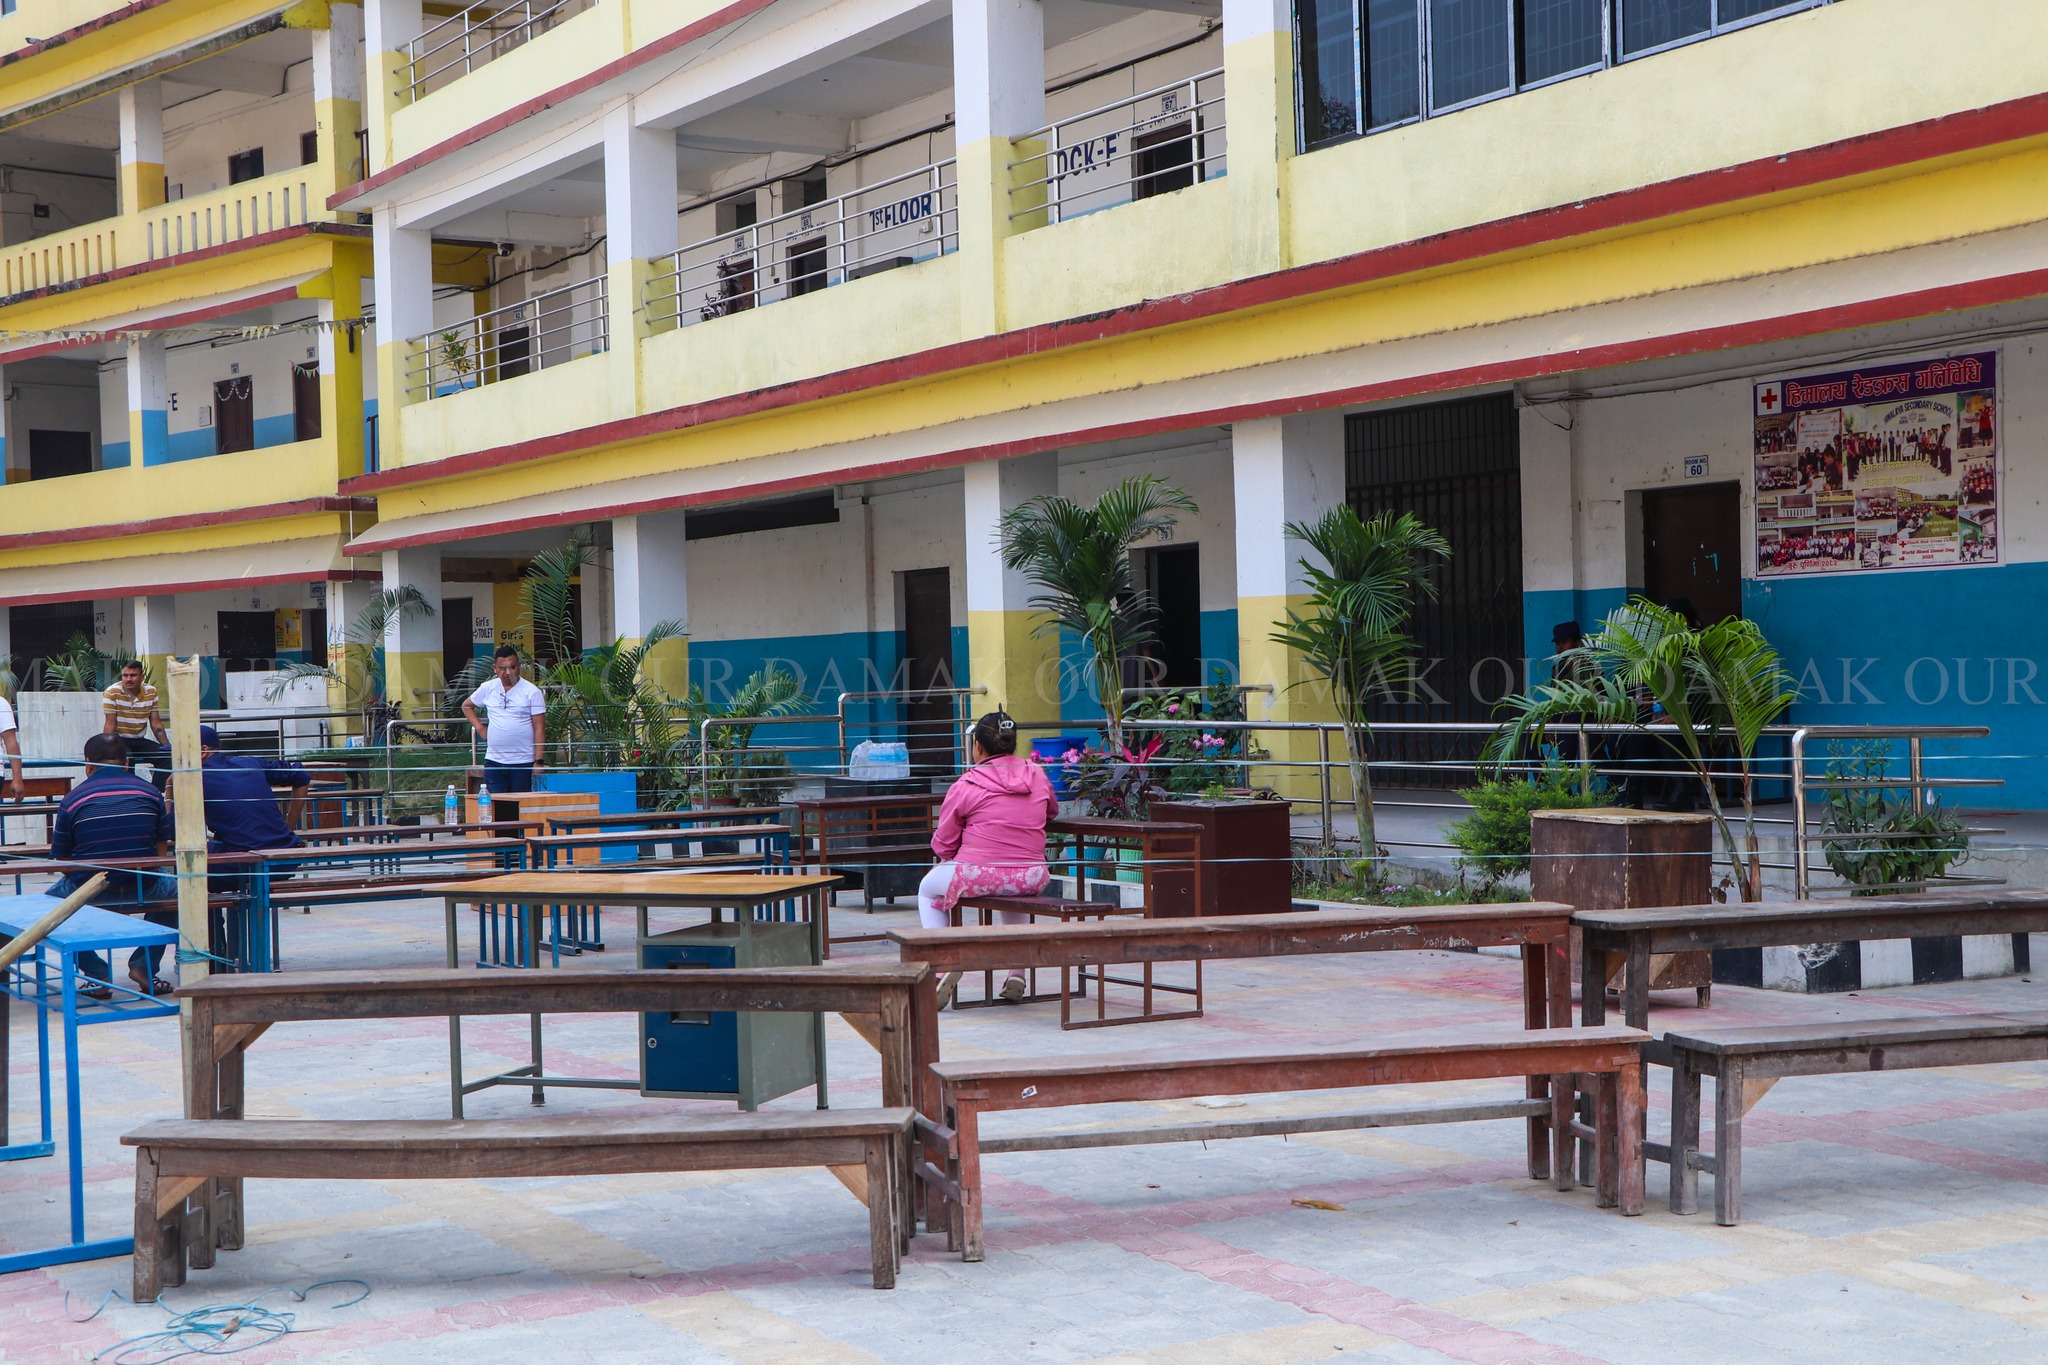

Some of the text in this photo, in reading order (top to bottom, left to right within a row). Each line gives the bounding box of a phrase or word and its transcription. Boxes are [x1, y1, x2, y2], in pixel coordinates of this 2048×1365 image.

[1165, 100, 1173, 110] 67
[884, 192, 933, 229] FLOOR
[1786, 358, 1982, 408] हिमालय रेडक्रस गतिविधि
[1904, 400, 1933, 411] SECONDARY
[1933, 402, 1954, 418] SCHOOL
[1691, 465, 1702, 476] 60
[476, 617, 489, 627] Girl's
[478, 628, 493, 638] TOILET
